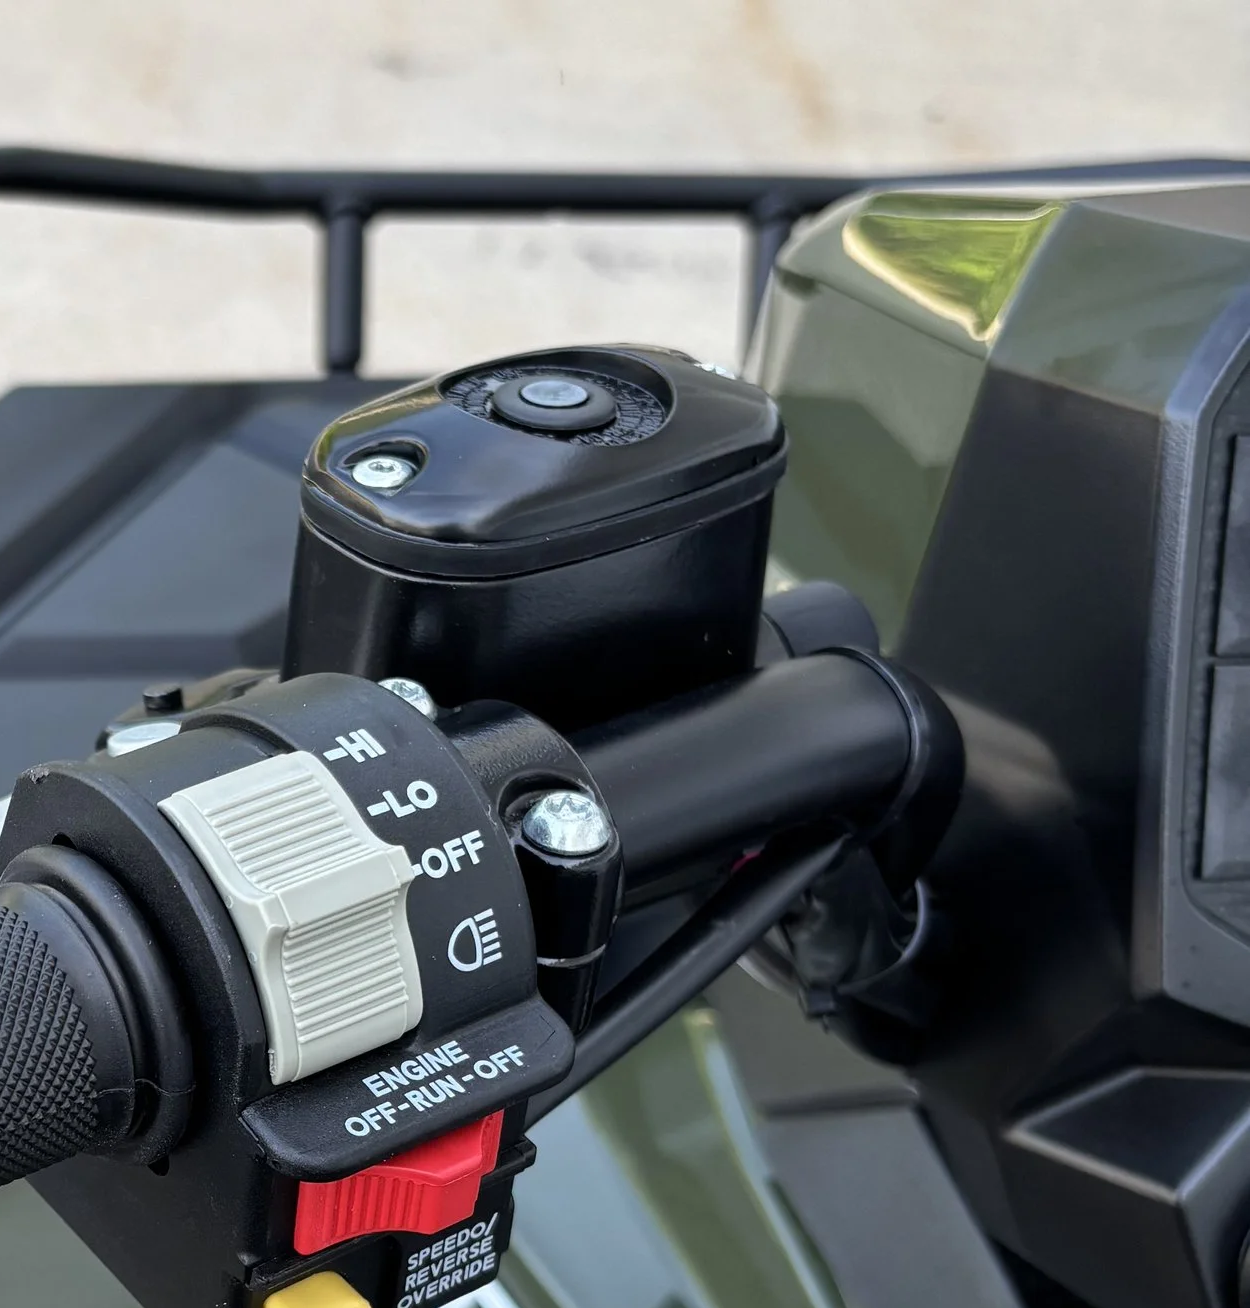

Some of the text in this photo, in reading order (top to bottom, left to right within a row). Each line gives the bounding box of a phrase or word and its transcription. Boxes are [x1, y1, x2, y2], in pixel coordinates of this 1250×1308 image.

[362, 1040, 470, 1098] ENGINE
[404, 1235, 494, 1291] REVERSE
[407, 1212, 499, 1272] SPEEDO/
